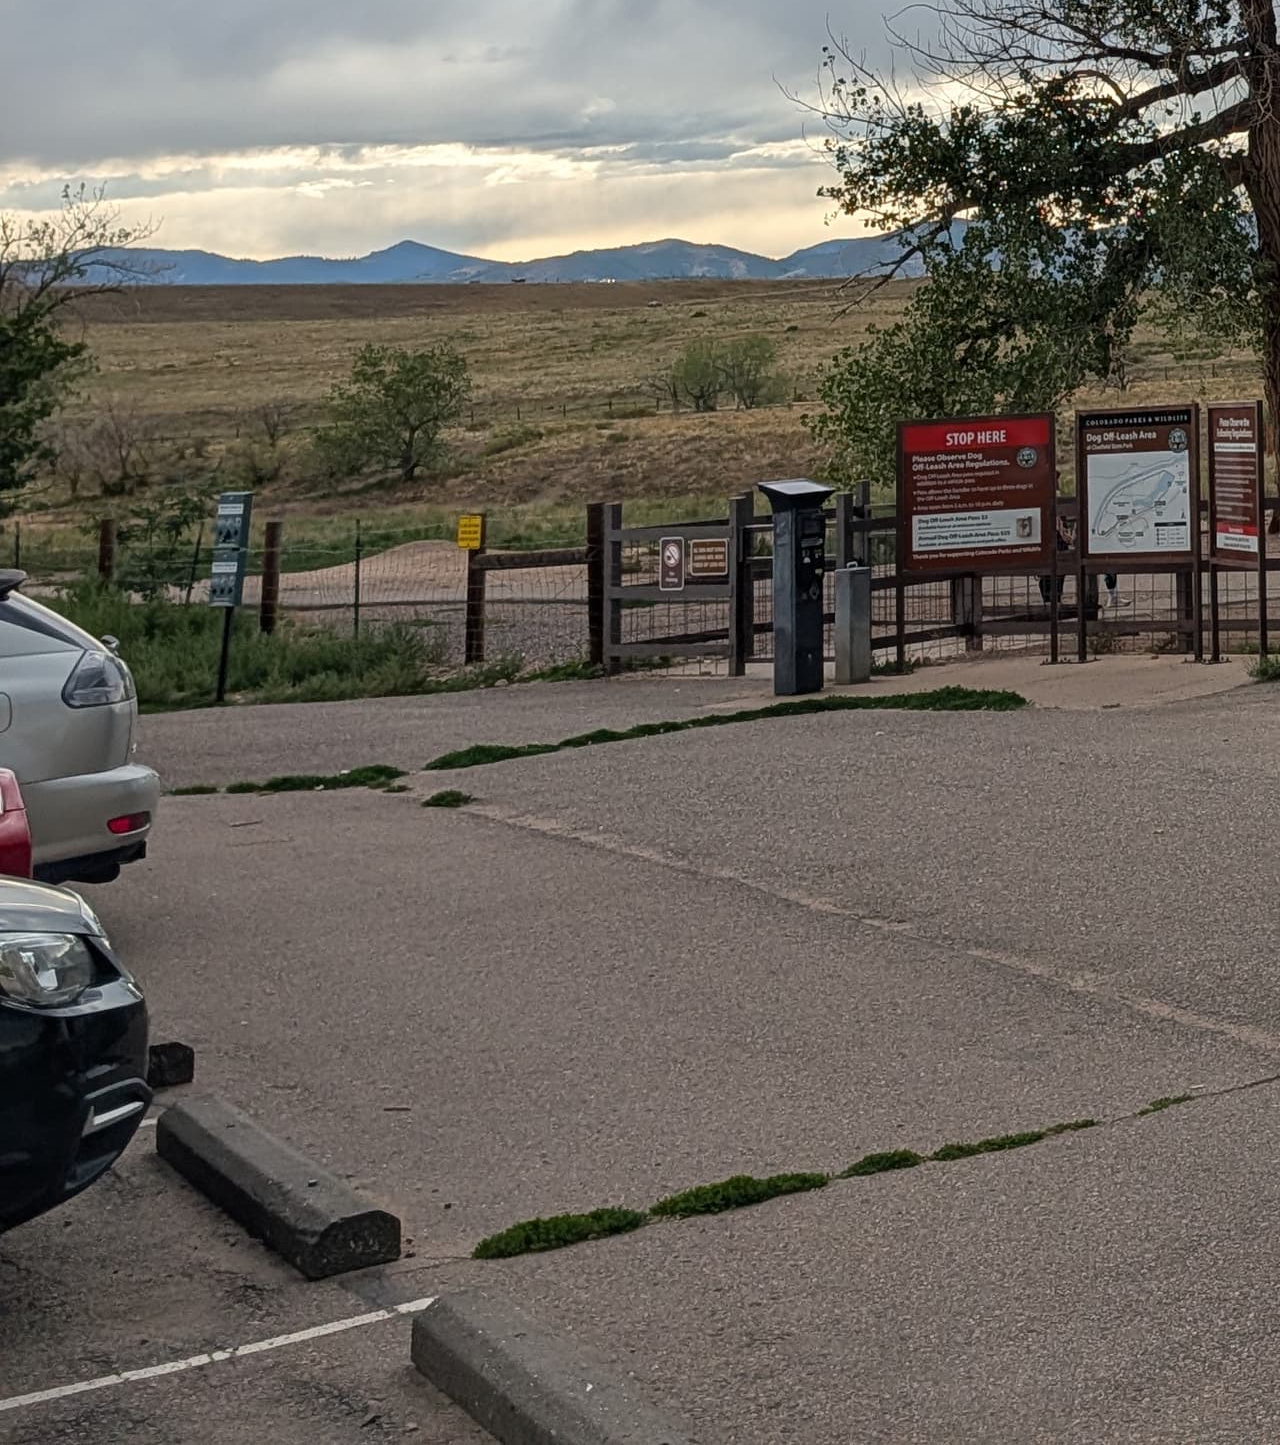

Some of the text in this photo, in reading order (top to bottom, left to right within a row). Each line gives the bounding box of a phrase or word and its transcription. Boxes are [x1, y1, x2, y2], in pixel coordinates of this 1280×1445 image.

[946, 430, 1007, 446] STOP HERE
[1086, 430, 1157, 444] Dog Off-Leash Area
[912, 455, 935, 463] Please
[967, 452, 983, 461] Dog
[912, 462, 947, 471] Off-Leash
[966, 459, 1010, 469] Regulations.
